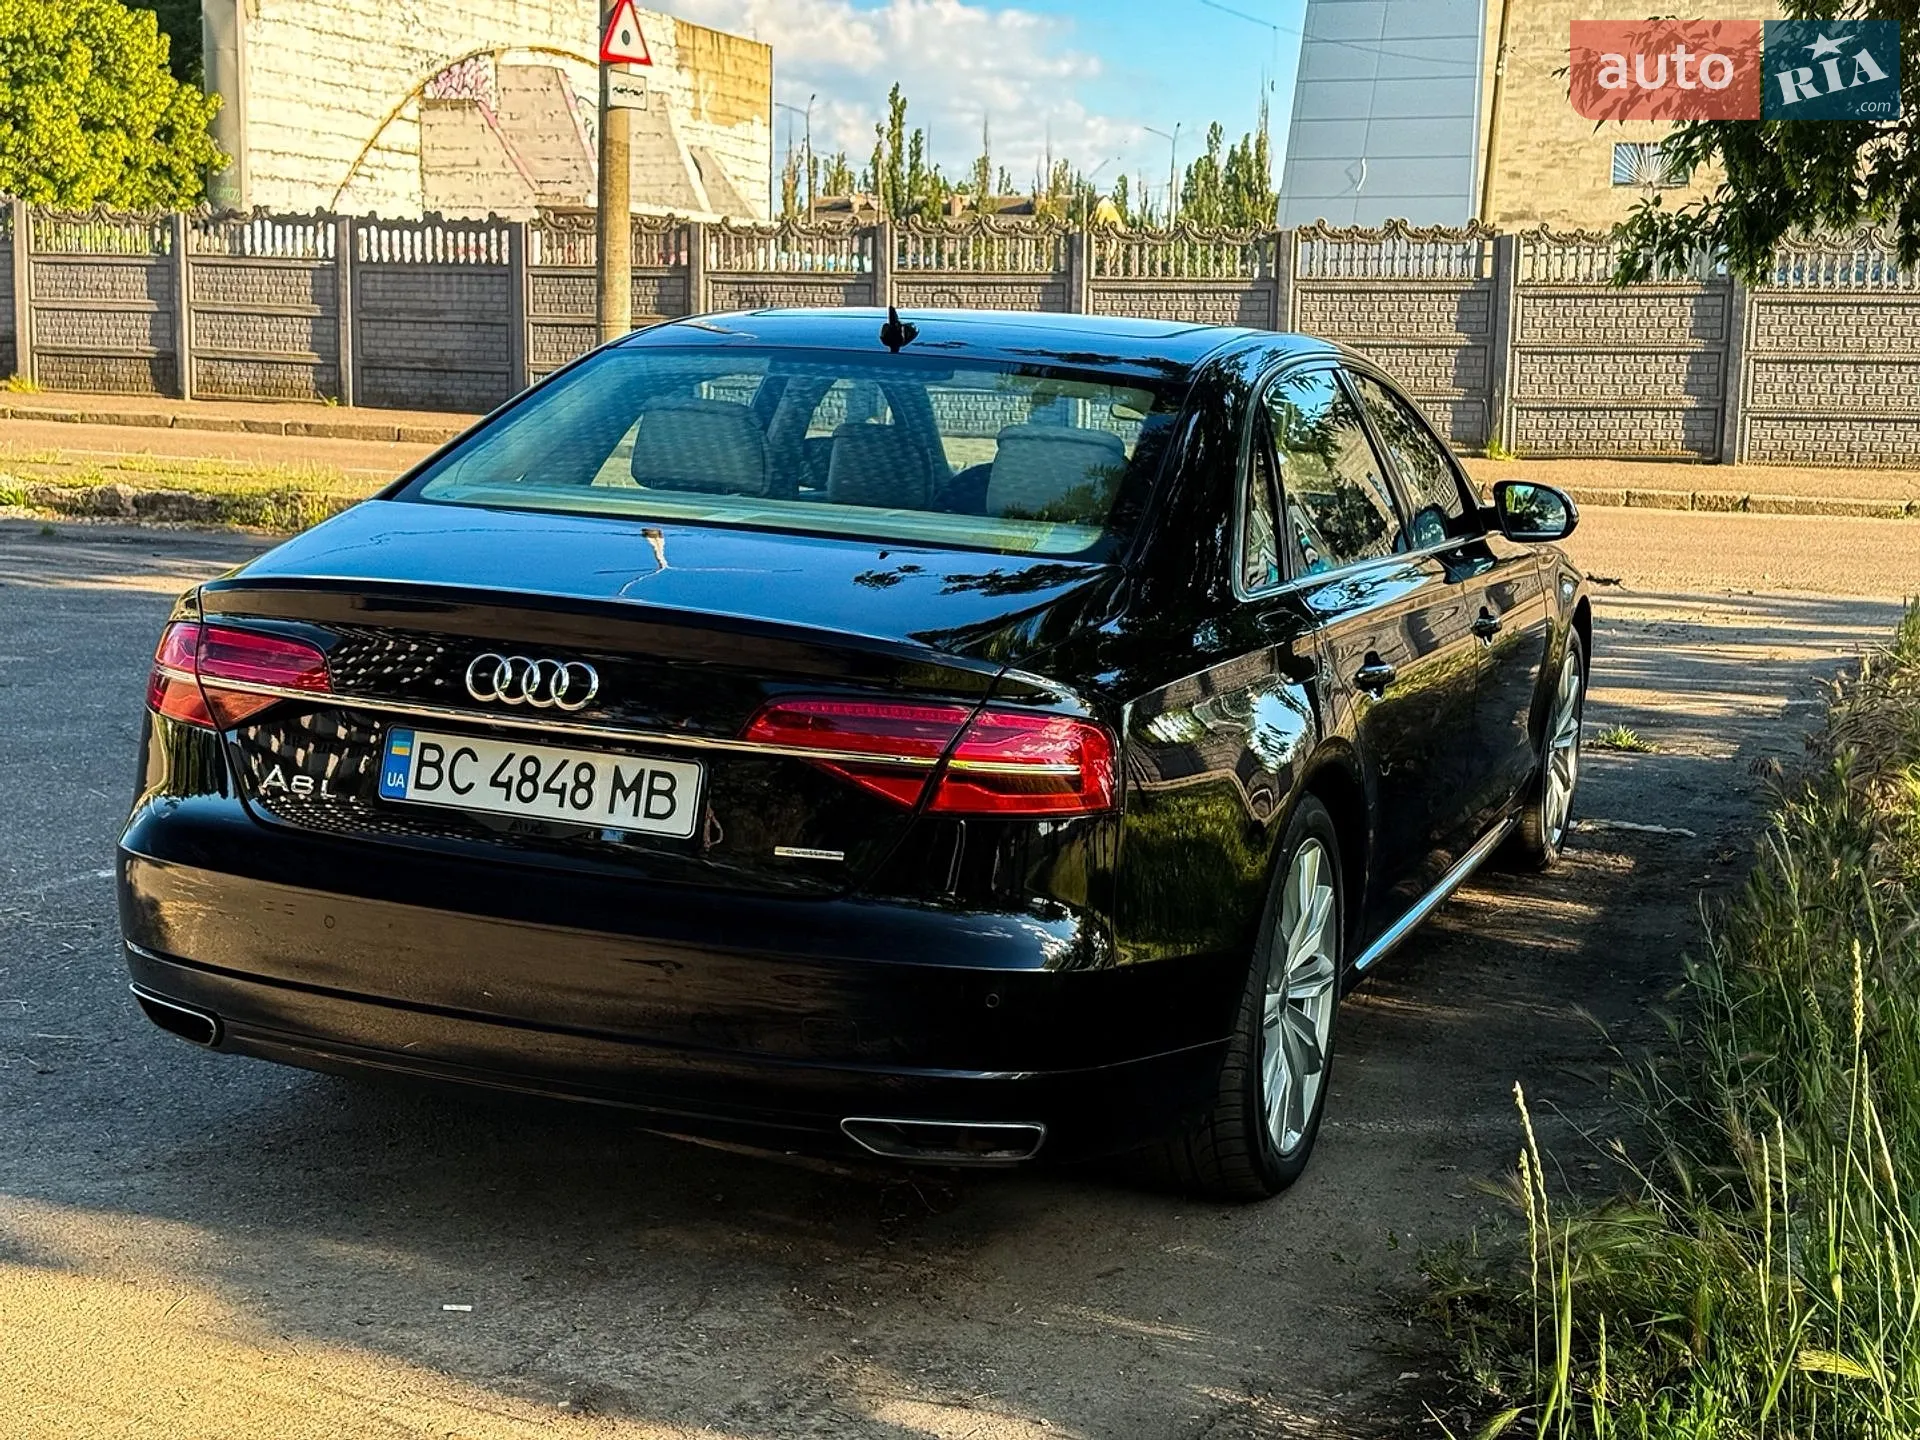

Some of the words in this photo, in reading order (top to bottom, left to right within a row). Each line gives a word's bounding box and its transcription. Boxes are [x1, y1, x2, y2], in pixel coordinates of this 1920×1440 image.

[387, 772, 405, 788] UA
[414, 741, 479, 796] BC
[489, 752, 596, 811] 4848
[608, 764, 677, 820] MB
